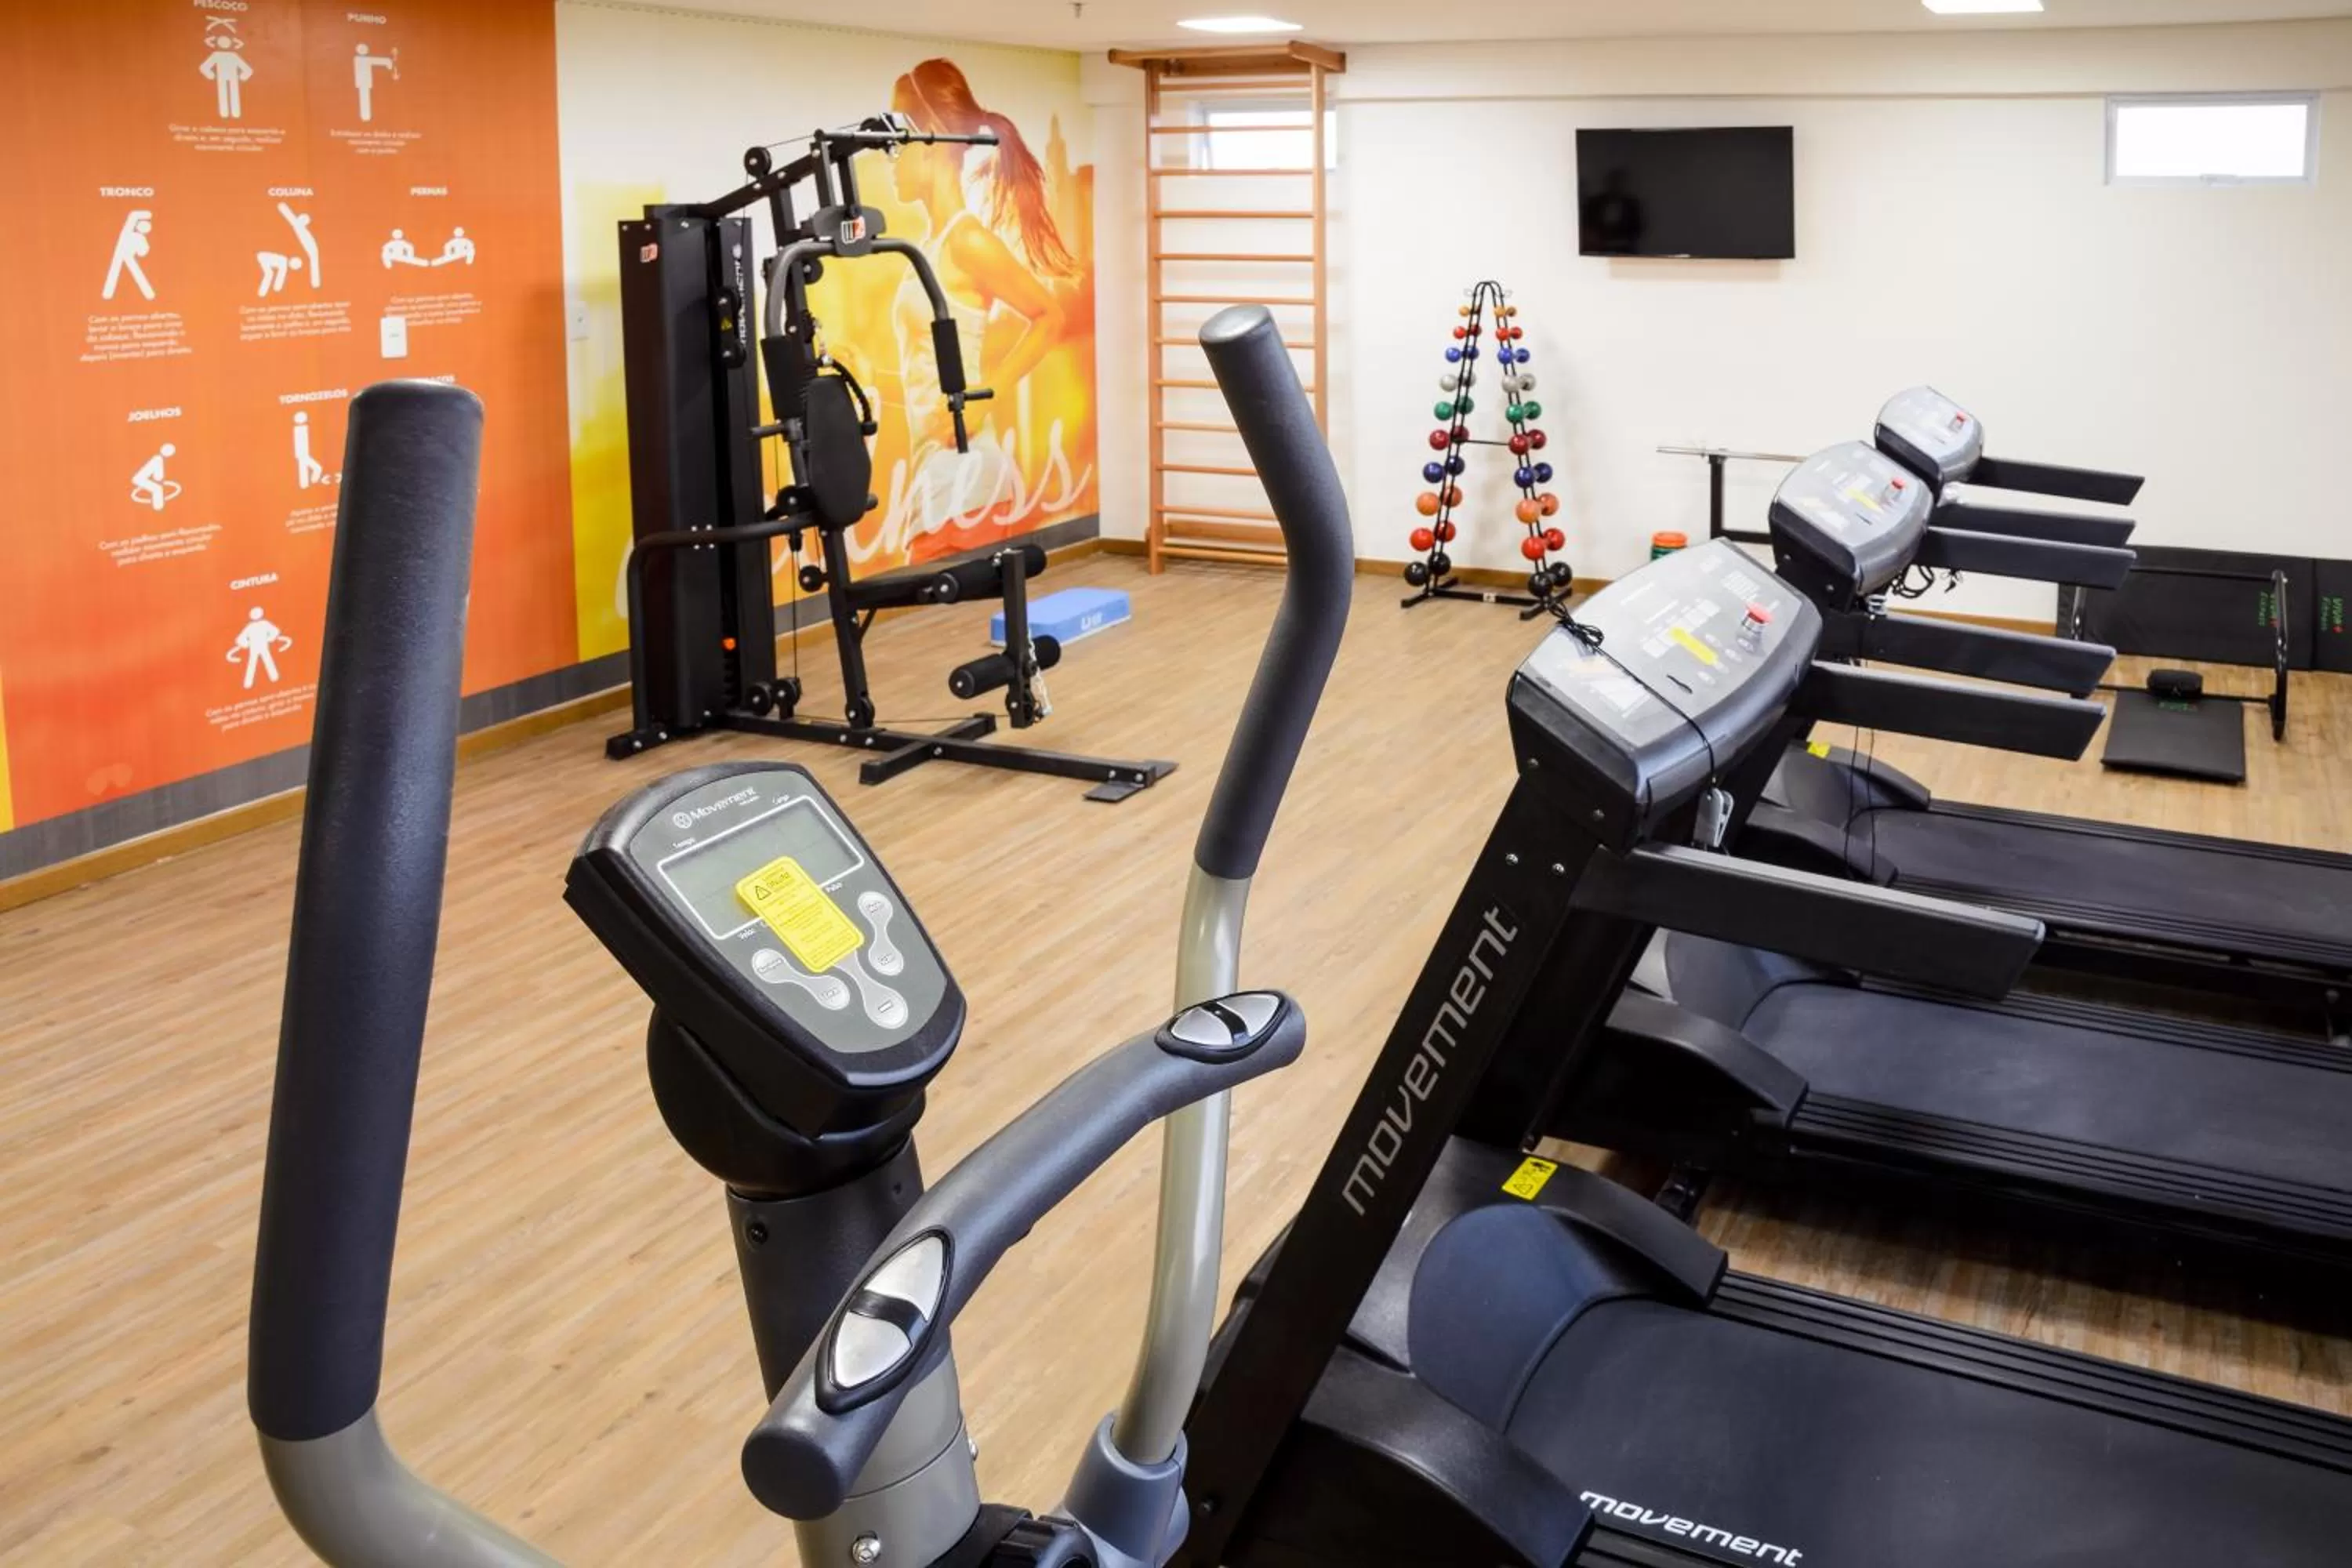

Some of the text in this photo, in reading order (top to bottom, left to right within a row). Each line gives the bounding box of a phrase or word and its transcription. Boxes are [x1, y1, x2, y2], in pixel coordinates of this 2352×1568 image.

[100, 186, 154, 198] TRONCO
[267, 187, 314, 198] COLUNA
[128, 407, 183, 423] JOELHOS
[229, 572, 280, 590] CINTURA
[689, 786, 757, 819] Movement
[1341, 906, 1519, 1217] movement
[1579, 1490, 1803, 1567] movement
